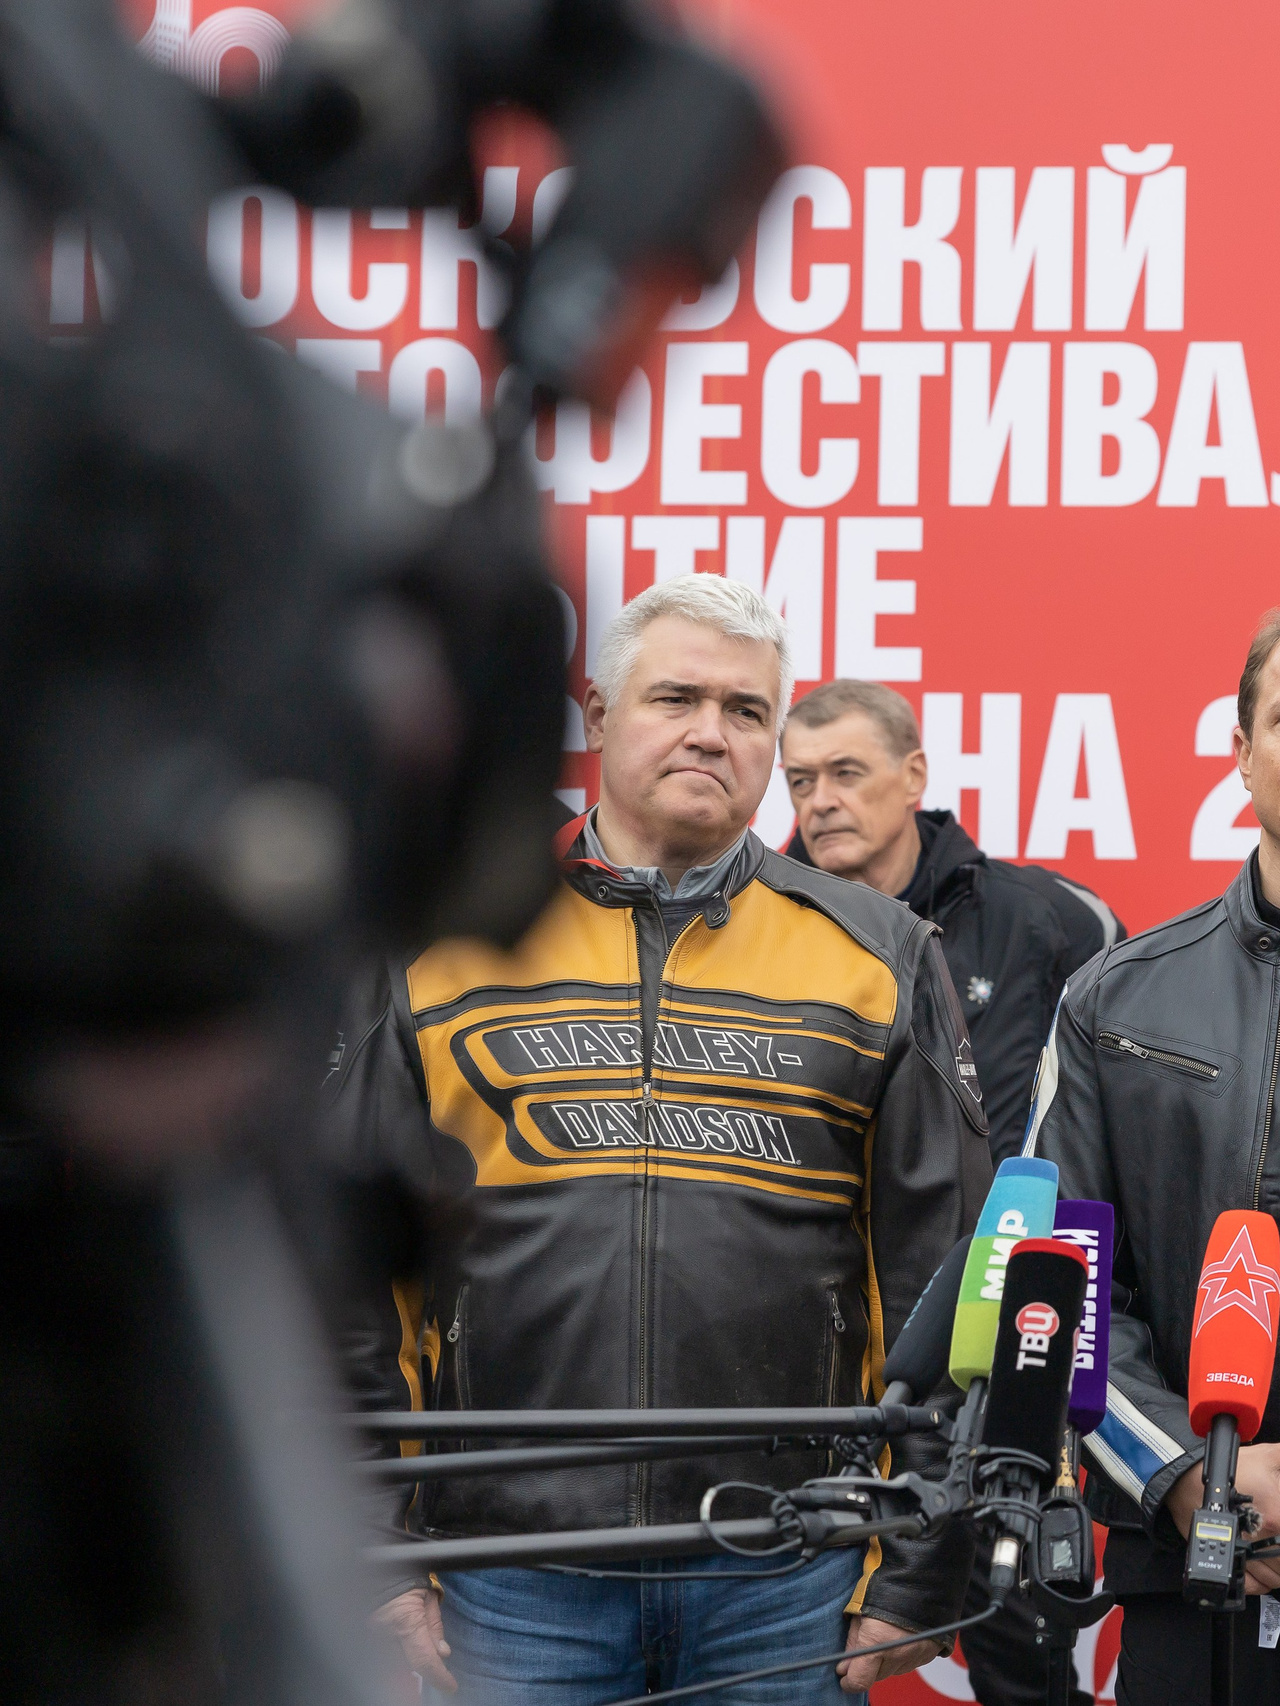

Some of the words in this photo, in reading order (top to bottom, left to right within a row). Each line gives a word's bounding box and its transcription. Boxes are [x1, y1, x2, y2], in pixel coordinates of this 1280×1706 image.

[513, 1022, 803, 1078] HARLEY-
[551, 1102, 796, 1165] DAVIDSON
[1016, 1309, 1056, 1371] ТВЦ
[1206, 1372, 1255, 1387] ЗВЕЗДА
